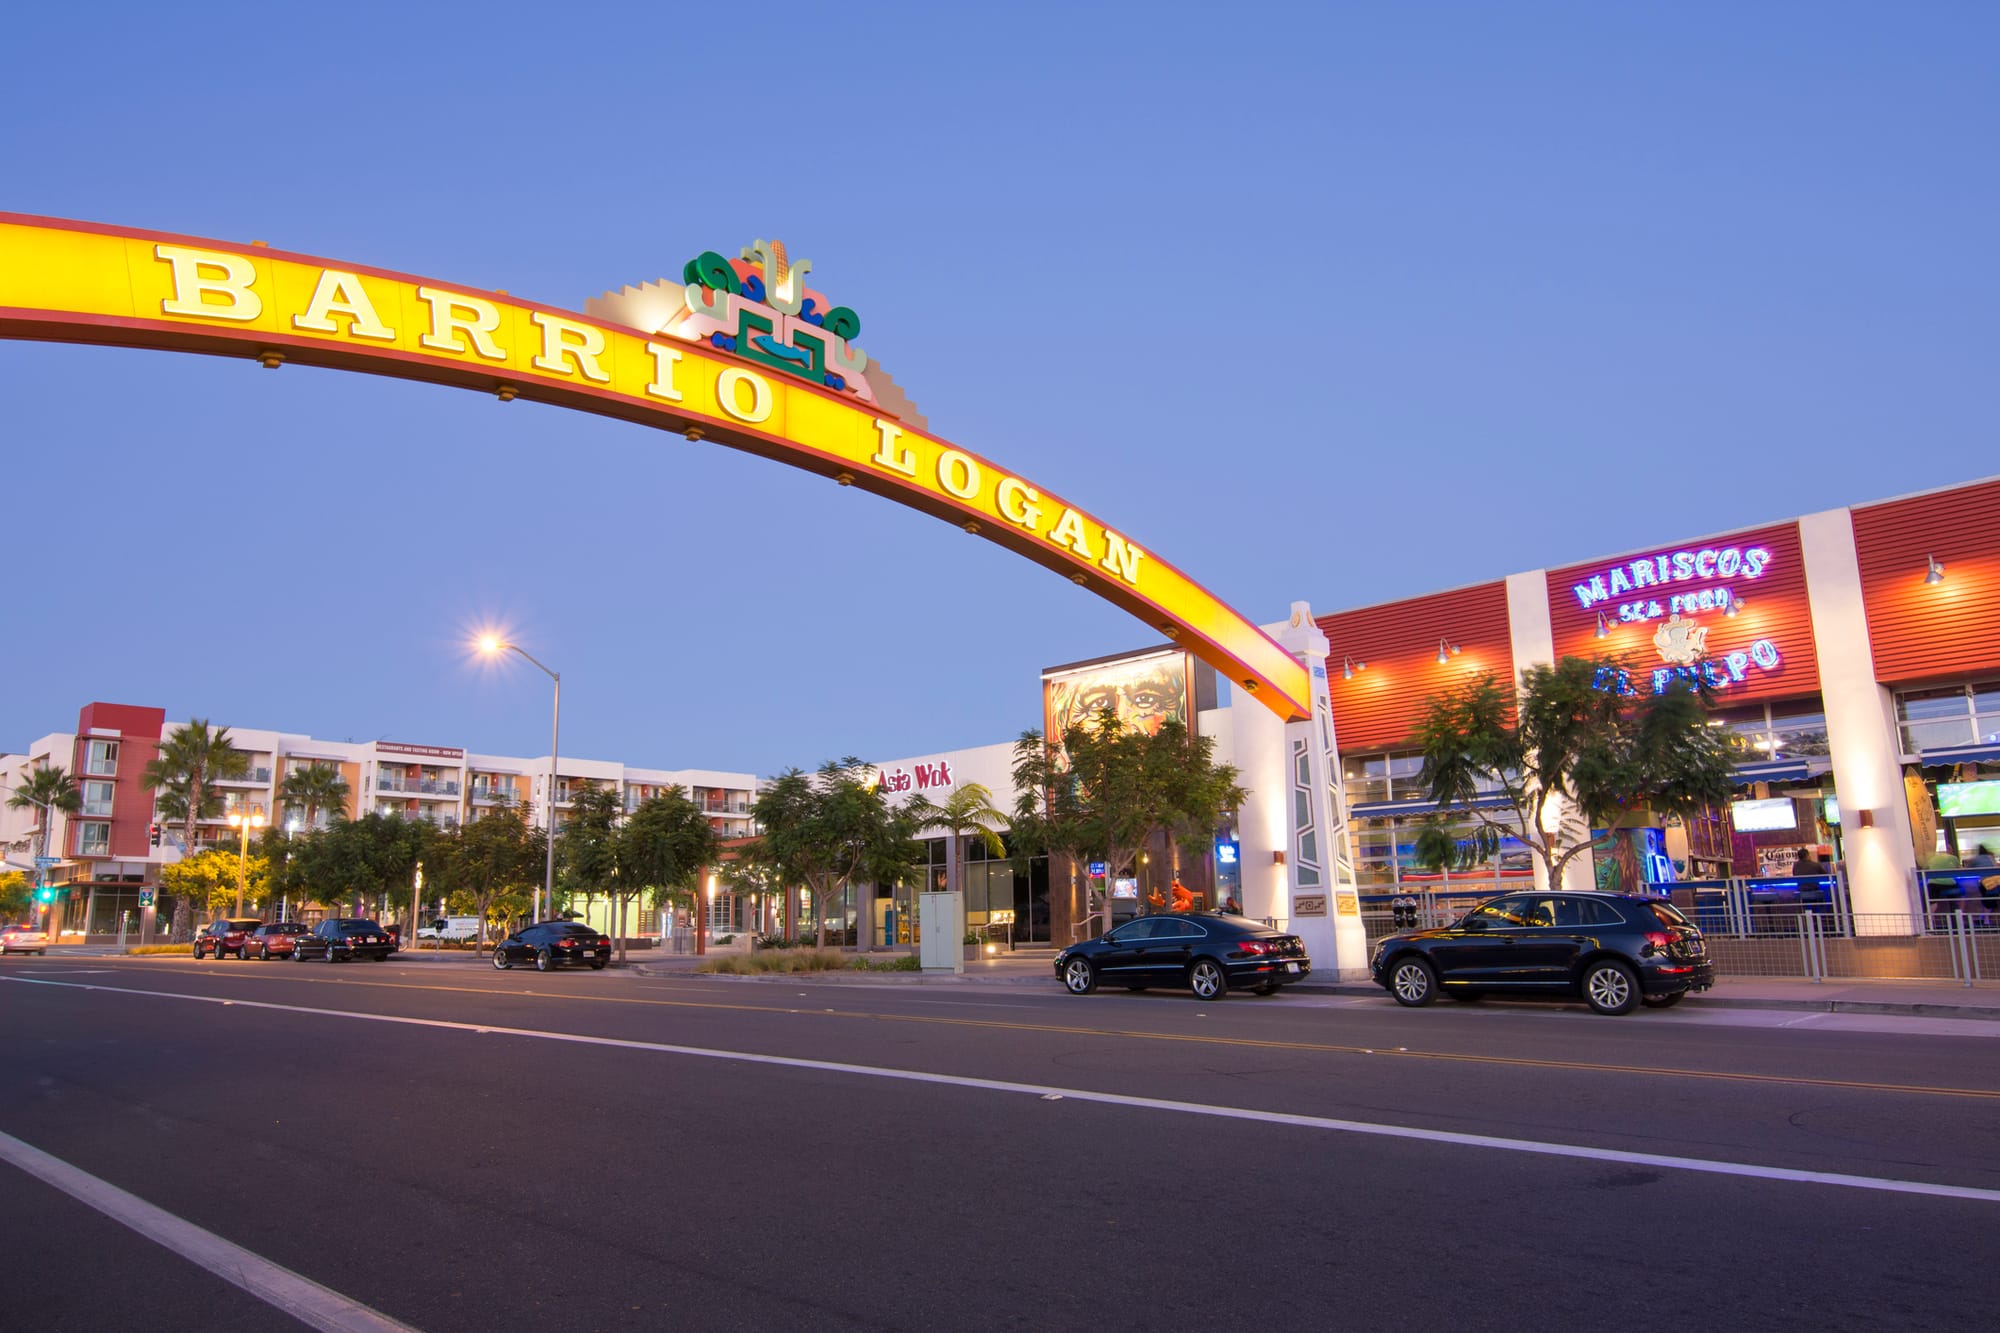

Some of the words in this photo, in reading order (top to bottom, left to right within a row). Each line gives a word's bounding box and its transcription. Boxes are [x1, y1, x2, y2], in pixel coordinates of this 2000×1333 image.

[154, 243, 774, 424] BARRIO
[870, 418, 1144, 585] LOGAN
[1573, 547, 1770, 608] MARISCOS
[1618, 600, 1661, 622] SEA
[1669, 587, 1728, 614] FOOD
[878, 768, 911, 792] Asia
[914, 761, 951, 789] Wok
[1765, 848, 1798, 862] Coron
